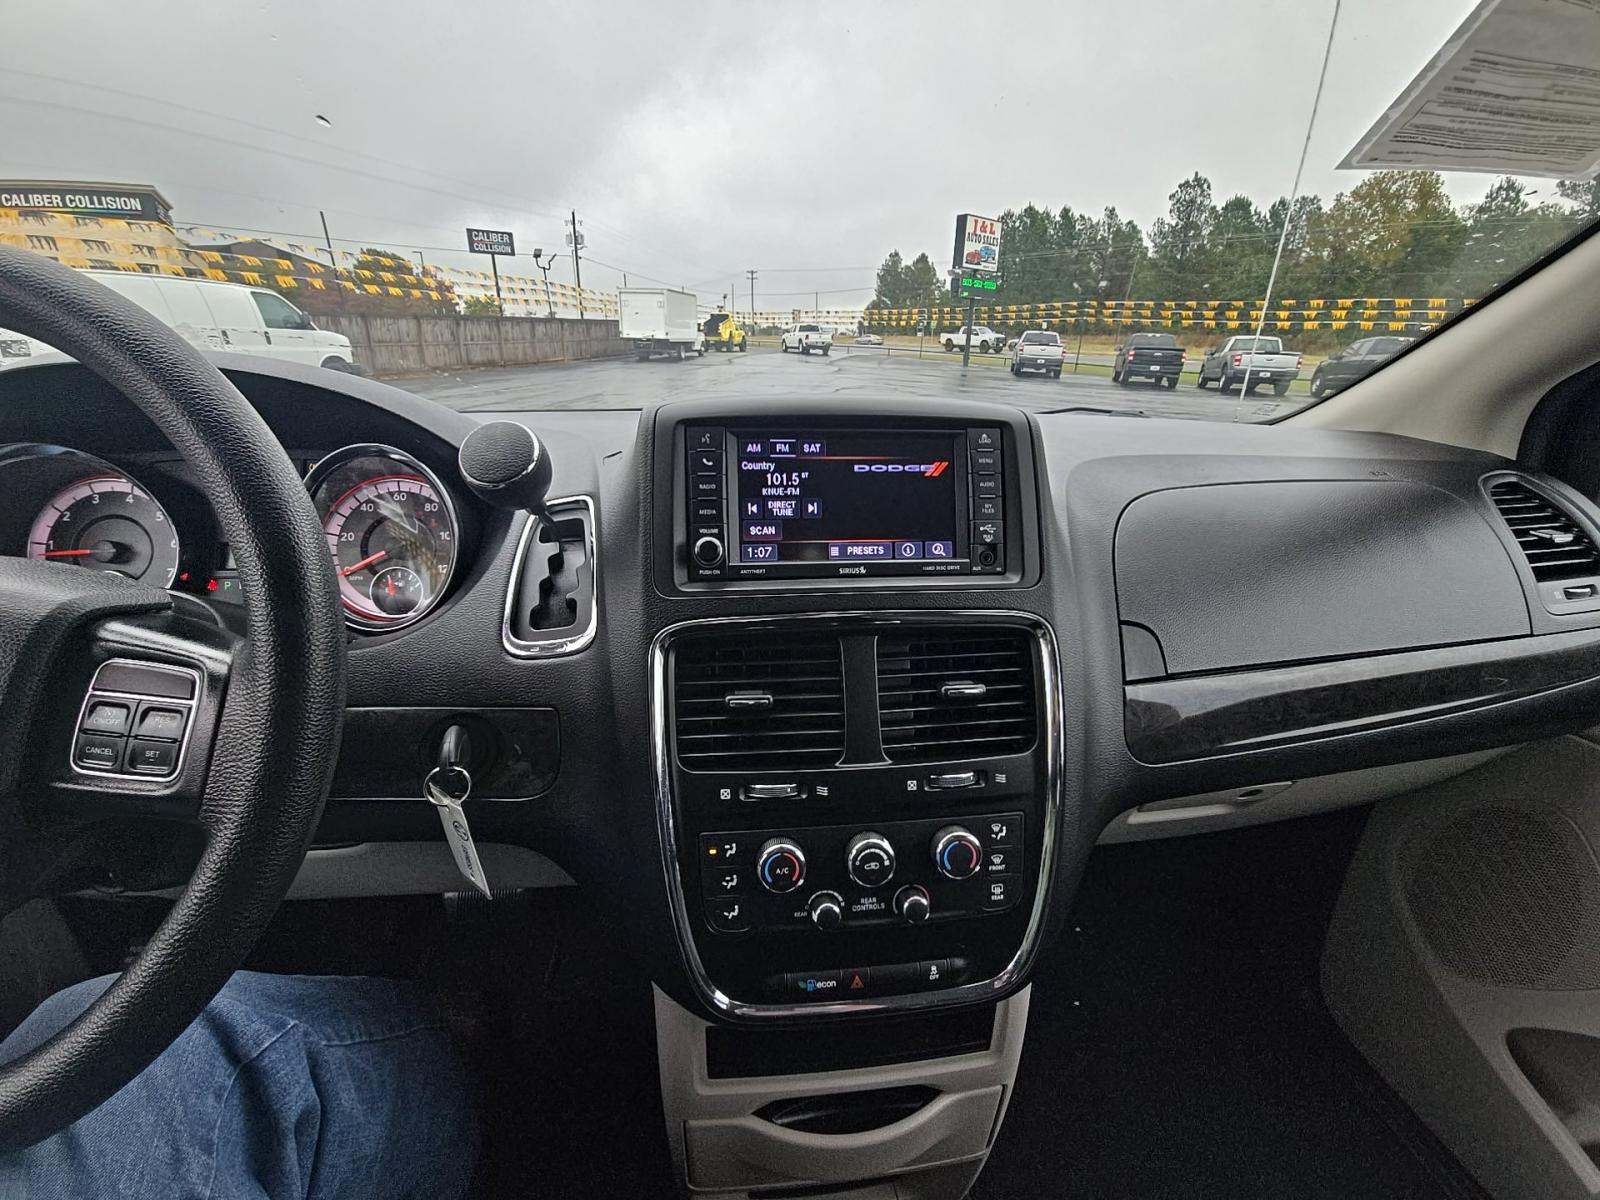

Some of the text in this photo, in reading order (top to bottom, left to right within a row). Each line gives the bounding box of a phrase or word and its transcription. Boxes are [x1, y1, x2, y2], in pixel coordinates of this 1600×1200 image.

[1, 194, 142, 211] CALIBER COLLISION
[980, 220, 988, 234] &
[989, 222, 996, 235] L
[472, 231, 510, 243] CALIBER
[966, 232, 999, 247] AUTO SALES
[473, 242, 512, 253] COLLISION
[746, 443, 762, 453] AM
[776, 443, 790, 453] FM
[803, 443, 822, 453] SAT
[741, 461, 776, 472] Country
[853, 464, 936, 473] DODGE
[766, 472, 800, 486] 101.5
[392, 492, 407, 501] 60
[762, 487, 800, 496] KNUE-FM
[91, 494, 101, 504] 3
[125, 494, 135, 503] 4
[360, 502, 374, 512] 40
[424, 502, 439, 512] 80
[767, 500, 797, 509] DIRECT
[61, 511, 71, 521] 2
[155, 511, 165, 521] 5
[772, 508, 794, 517] TUNE
[749, 525, 776, 536] SCAN
[340, 531, 355, 542] 20
[48, 540, 54, 550] 1
[747, 546, 772, 558] 1:07
[847, 545, 885, 556] PRESETS
[166, 568, 176, 578] 7
[224, 581, 231, 590] P
[85, 746, 114, 756] CANCEL
[145, 750, 160, 758] SET
[775, 867, 789, 875] A/C
[851, 903, 885, 912] CONTROLS
[816, 979, 837, 989] econ
